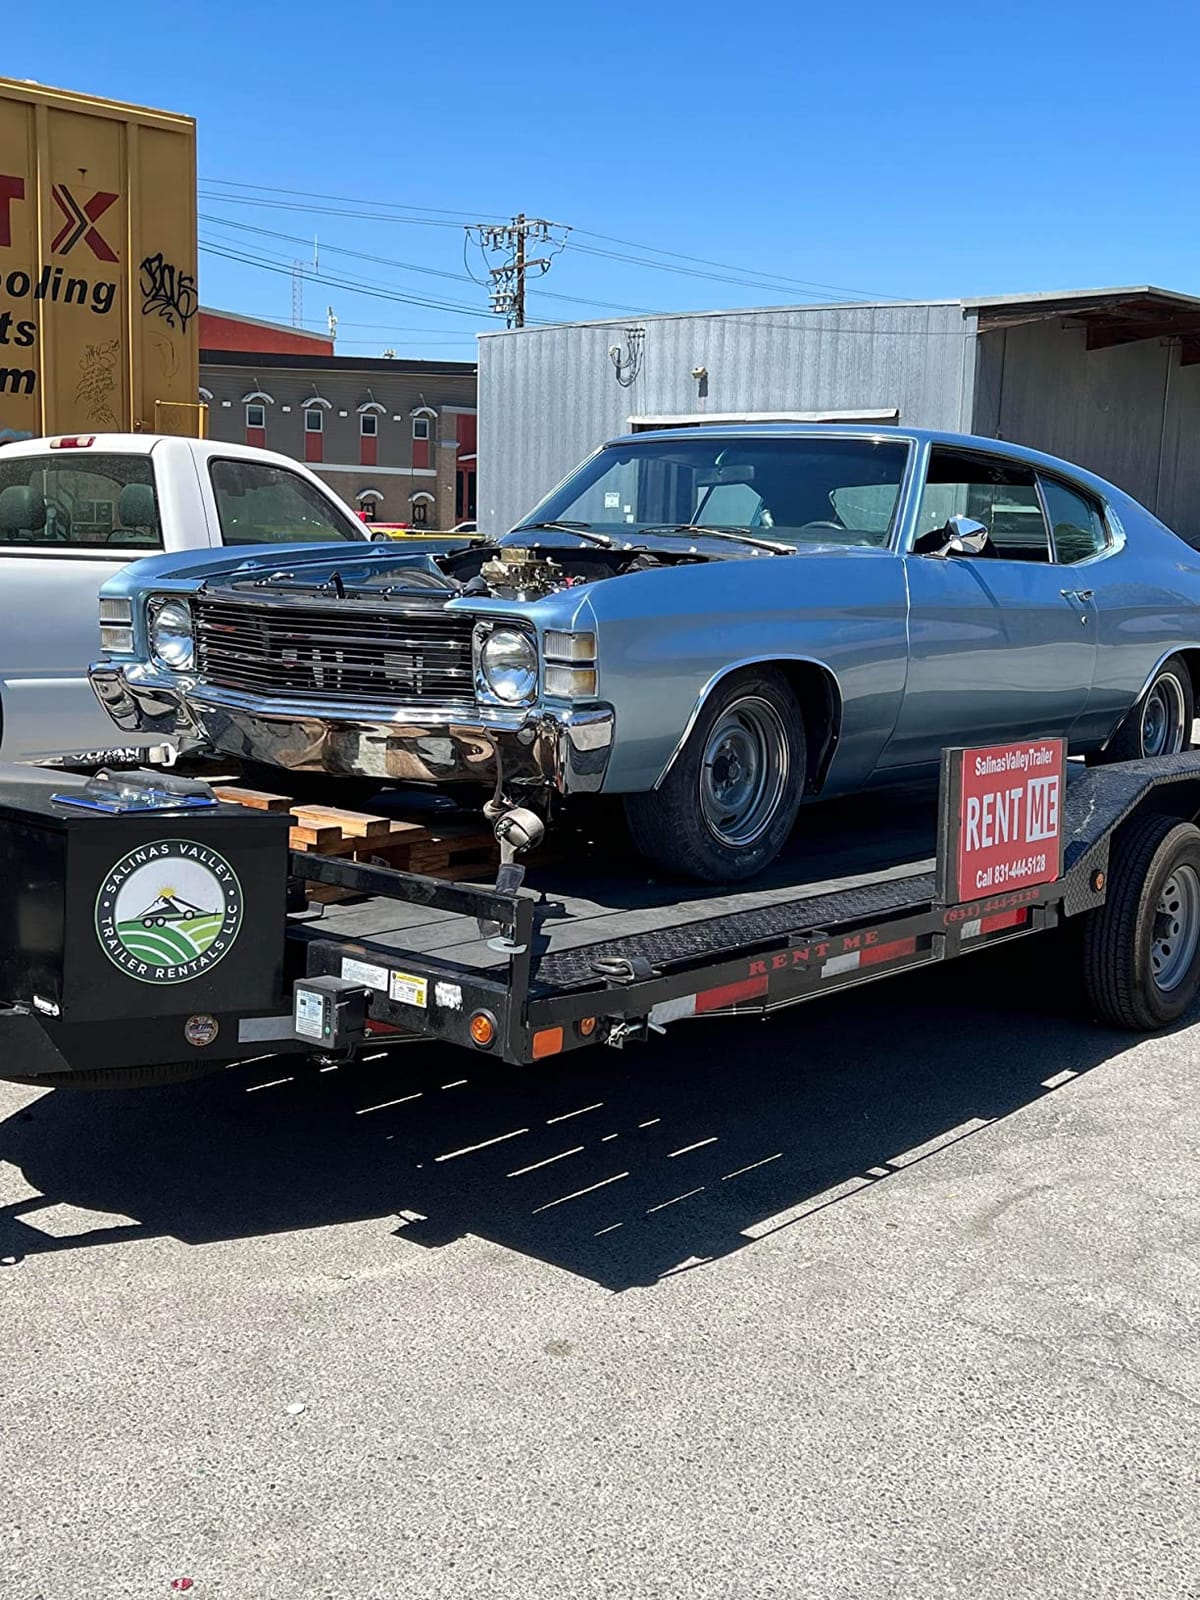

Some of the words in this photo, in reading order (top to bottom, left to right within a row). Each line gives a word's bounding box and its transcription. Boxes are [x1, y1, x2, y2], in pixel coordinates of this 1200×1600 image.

[0, 265, 116, 314] oling
[966, 787, 1023, 851] RENT
[1029, 780, 1057, 838] ME
[106, 844, 169, 893] SALINAS
[179, 844, 232, 882] VALLEY
[976, 868, 993, 888] Call
[994, 854, 1046, 884] 831-444-5128
[101, 917, 148, 974] TRAILER
[155, 941, 224, 978] RENTALS
[223, 904, 237, 934] LLC
[749, 942, 831, 976] RENT
[843, 931, 878, 950] ME
